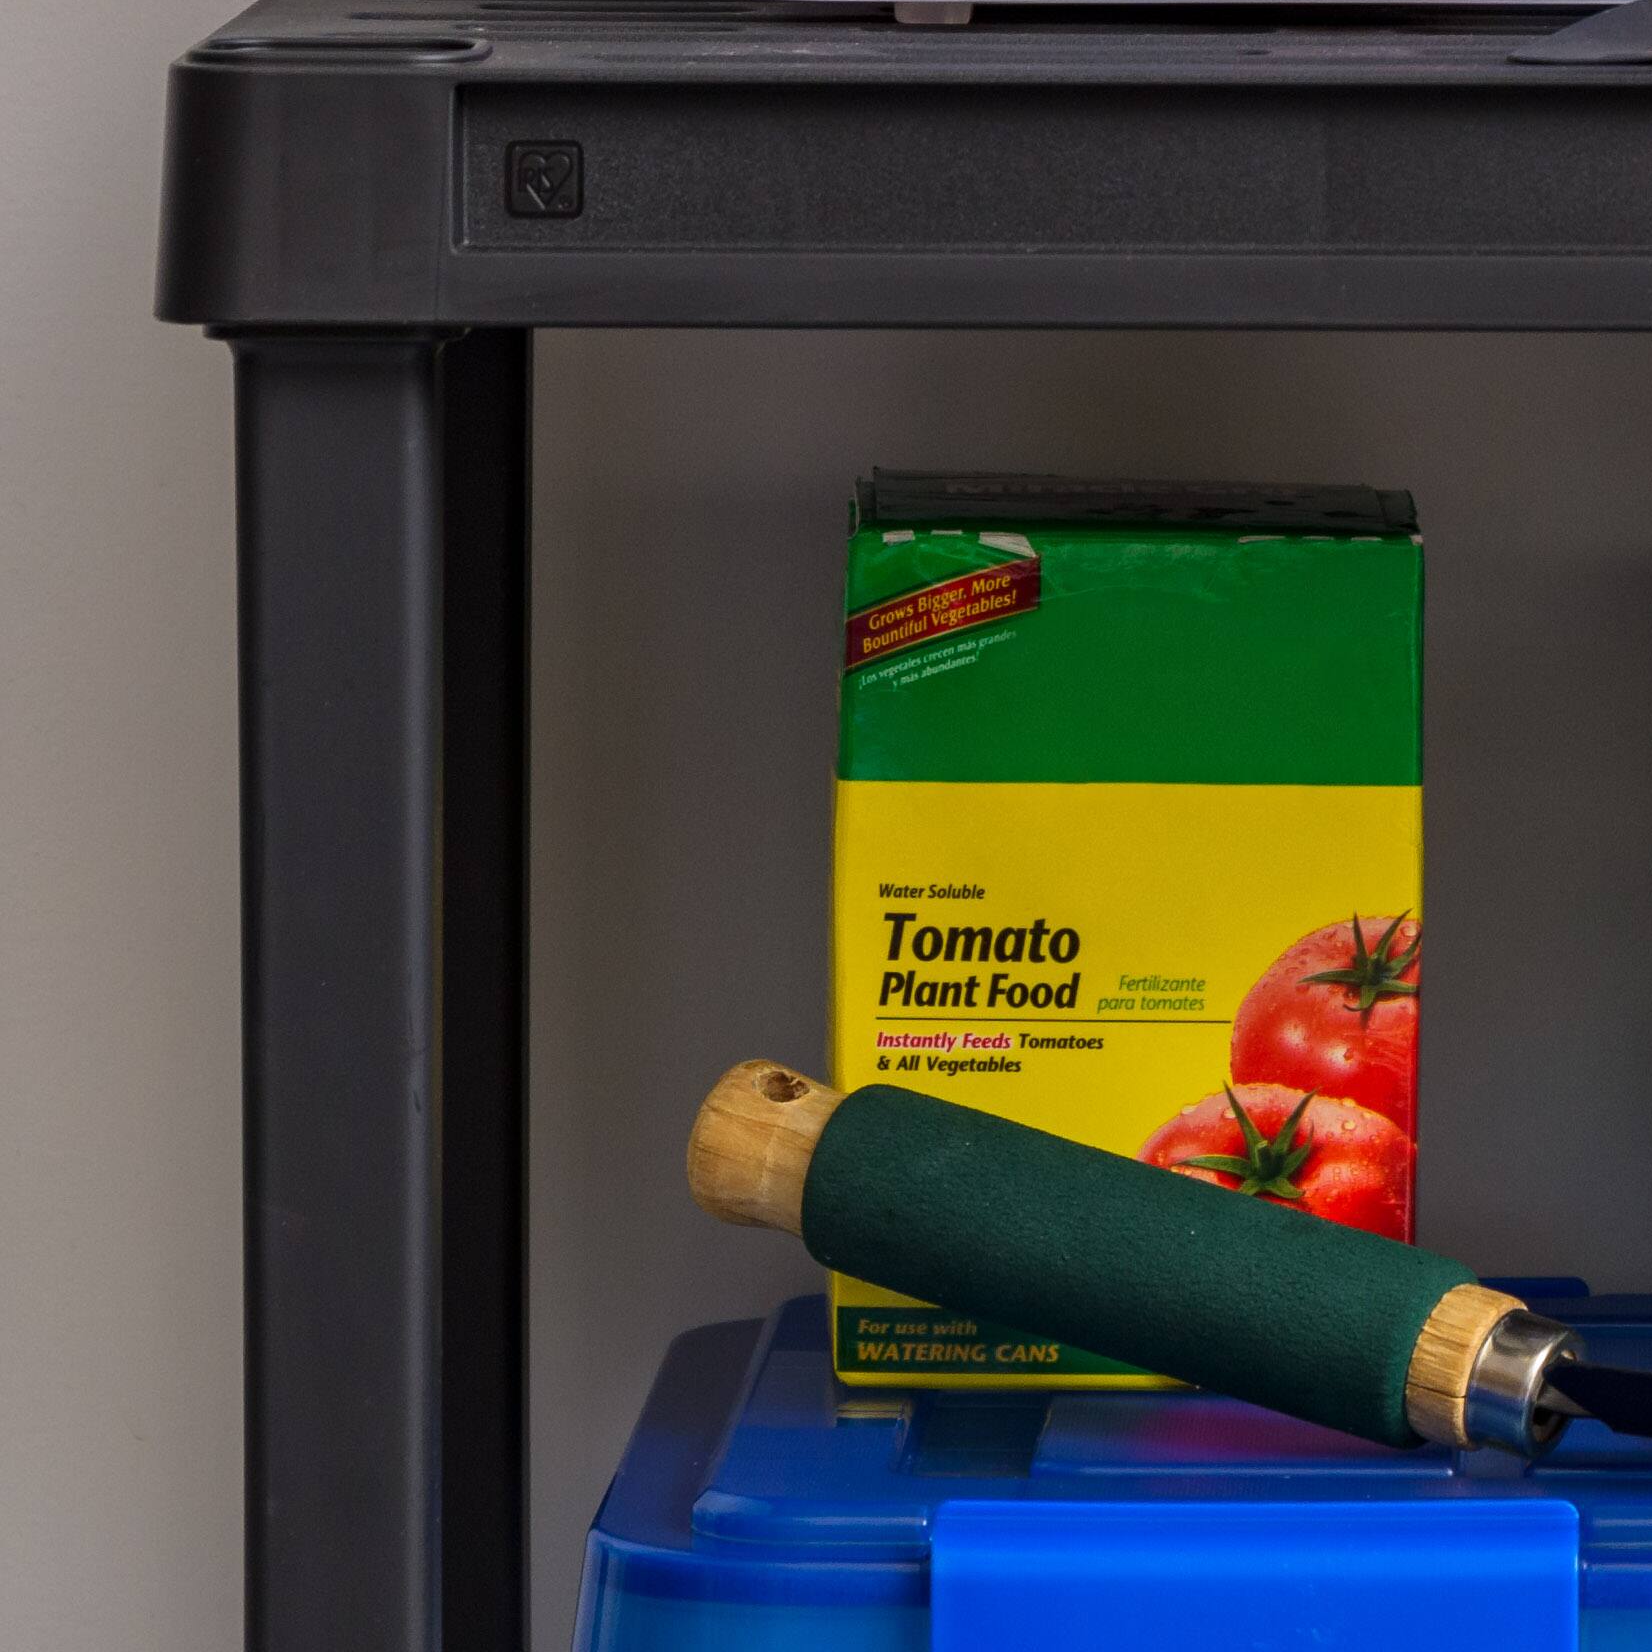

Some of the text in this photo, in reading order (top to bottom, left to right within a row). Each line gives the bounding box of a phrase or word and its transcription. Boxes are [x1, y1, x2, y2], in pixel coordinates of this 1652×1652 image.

[868, 603, 914, 630] Grows
[971, 574, 1012, 596] More
[863, 589, 1017, 654] Bountiful Vegetables!
[879, 656, 922, 678] vegetales
[923, 647, 955, 664] crecen
[978, 629, 1017, 650] grandes
[878, 884, 986, 900] Water Soluble
[883, 913, 1080, 963] Tomato
[879, 971, 1080, 1010] Plant Food
[1119, 974, 1206, 993] Fertilizante
[1097, 995, 1206, 1015] para tomates
[876, 1031, 1104, 1053] Instantly Feeds Tomatoes
[876, 1055, 1022, 1076] & All Vegetables
[857, 1318, 977, 1336] For use with
[857, 1341, 1060, 1363] WATERING CANS
